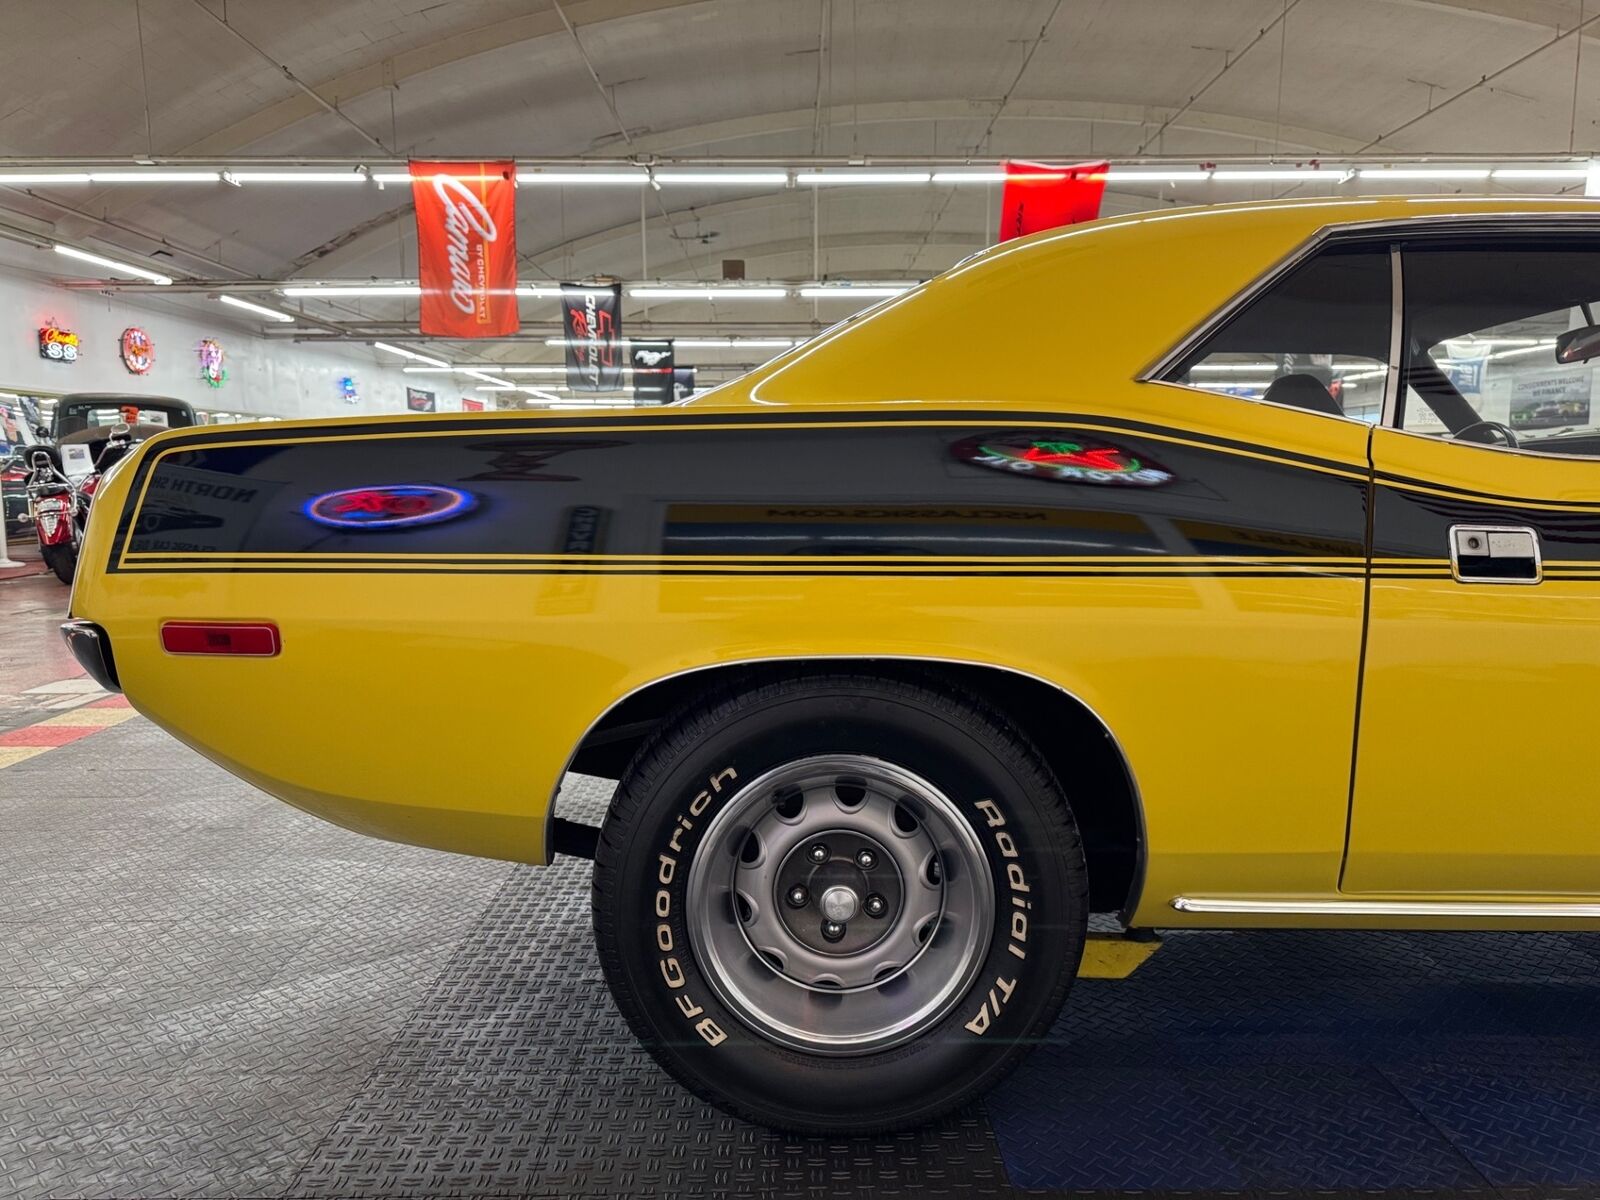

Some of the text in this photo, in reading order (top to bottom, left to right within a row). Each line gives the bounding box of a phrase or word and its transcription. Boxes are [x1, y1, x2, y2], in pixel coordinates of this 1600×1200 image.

[433, 174, 494, 315] Camaro
[475, 244, 483, 256] BY
[46, 342, 78, 361] SS
[569, 308, 588, 363] Racng
[585, 294, 599, 386] CHEVROLET
[1542, 386, 1566, 395] FINANCE
[1558, 375, 1585, 386] WELCOME
[655, 766, 738, 1048] BFGoodrich
[963, 799, 1032, 1037] Radial T/A
